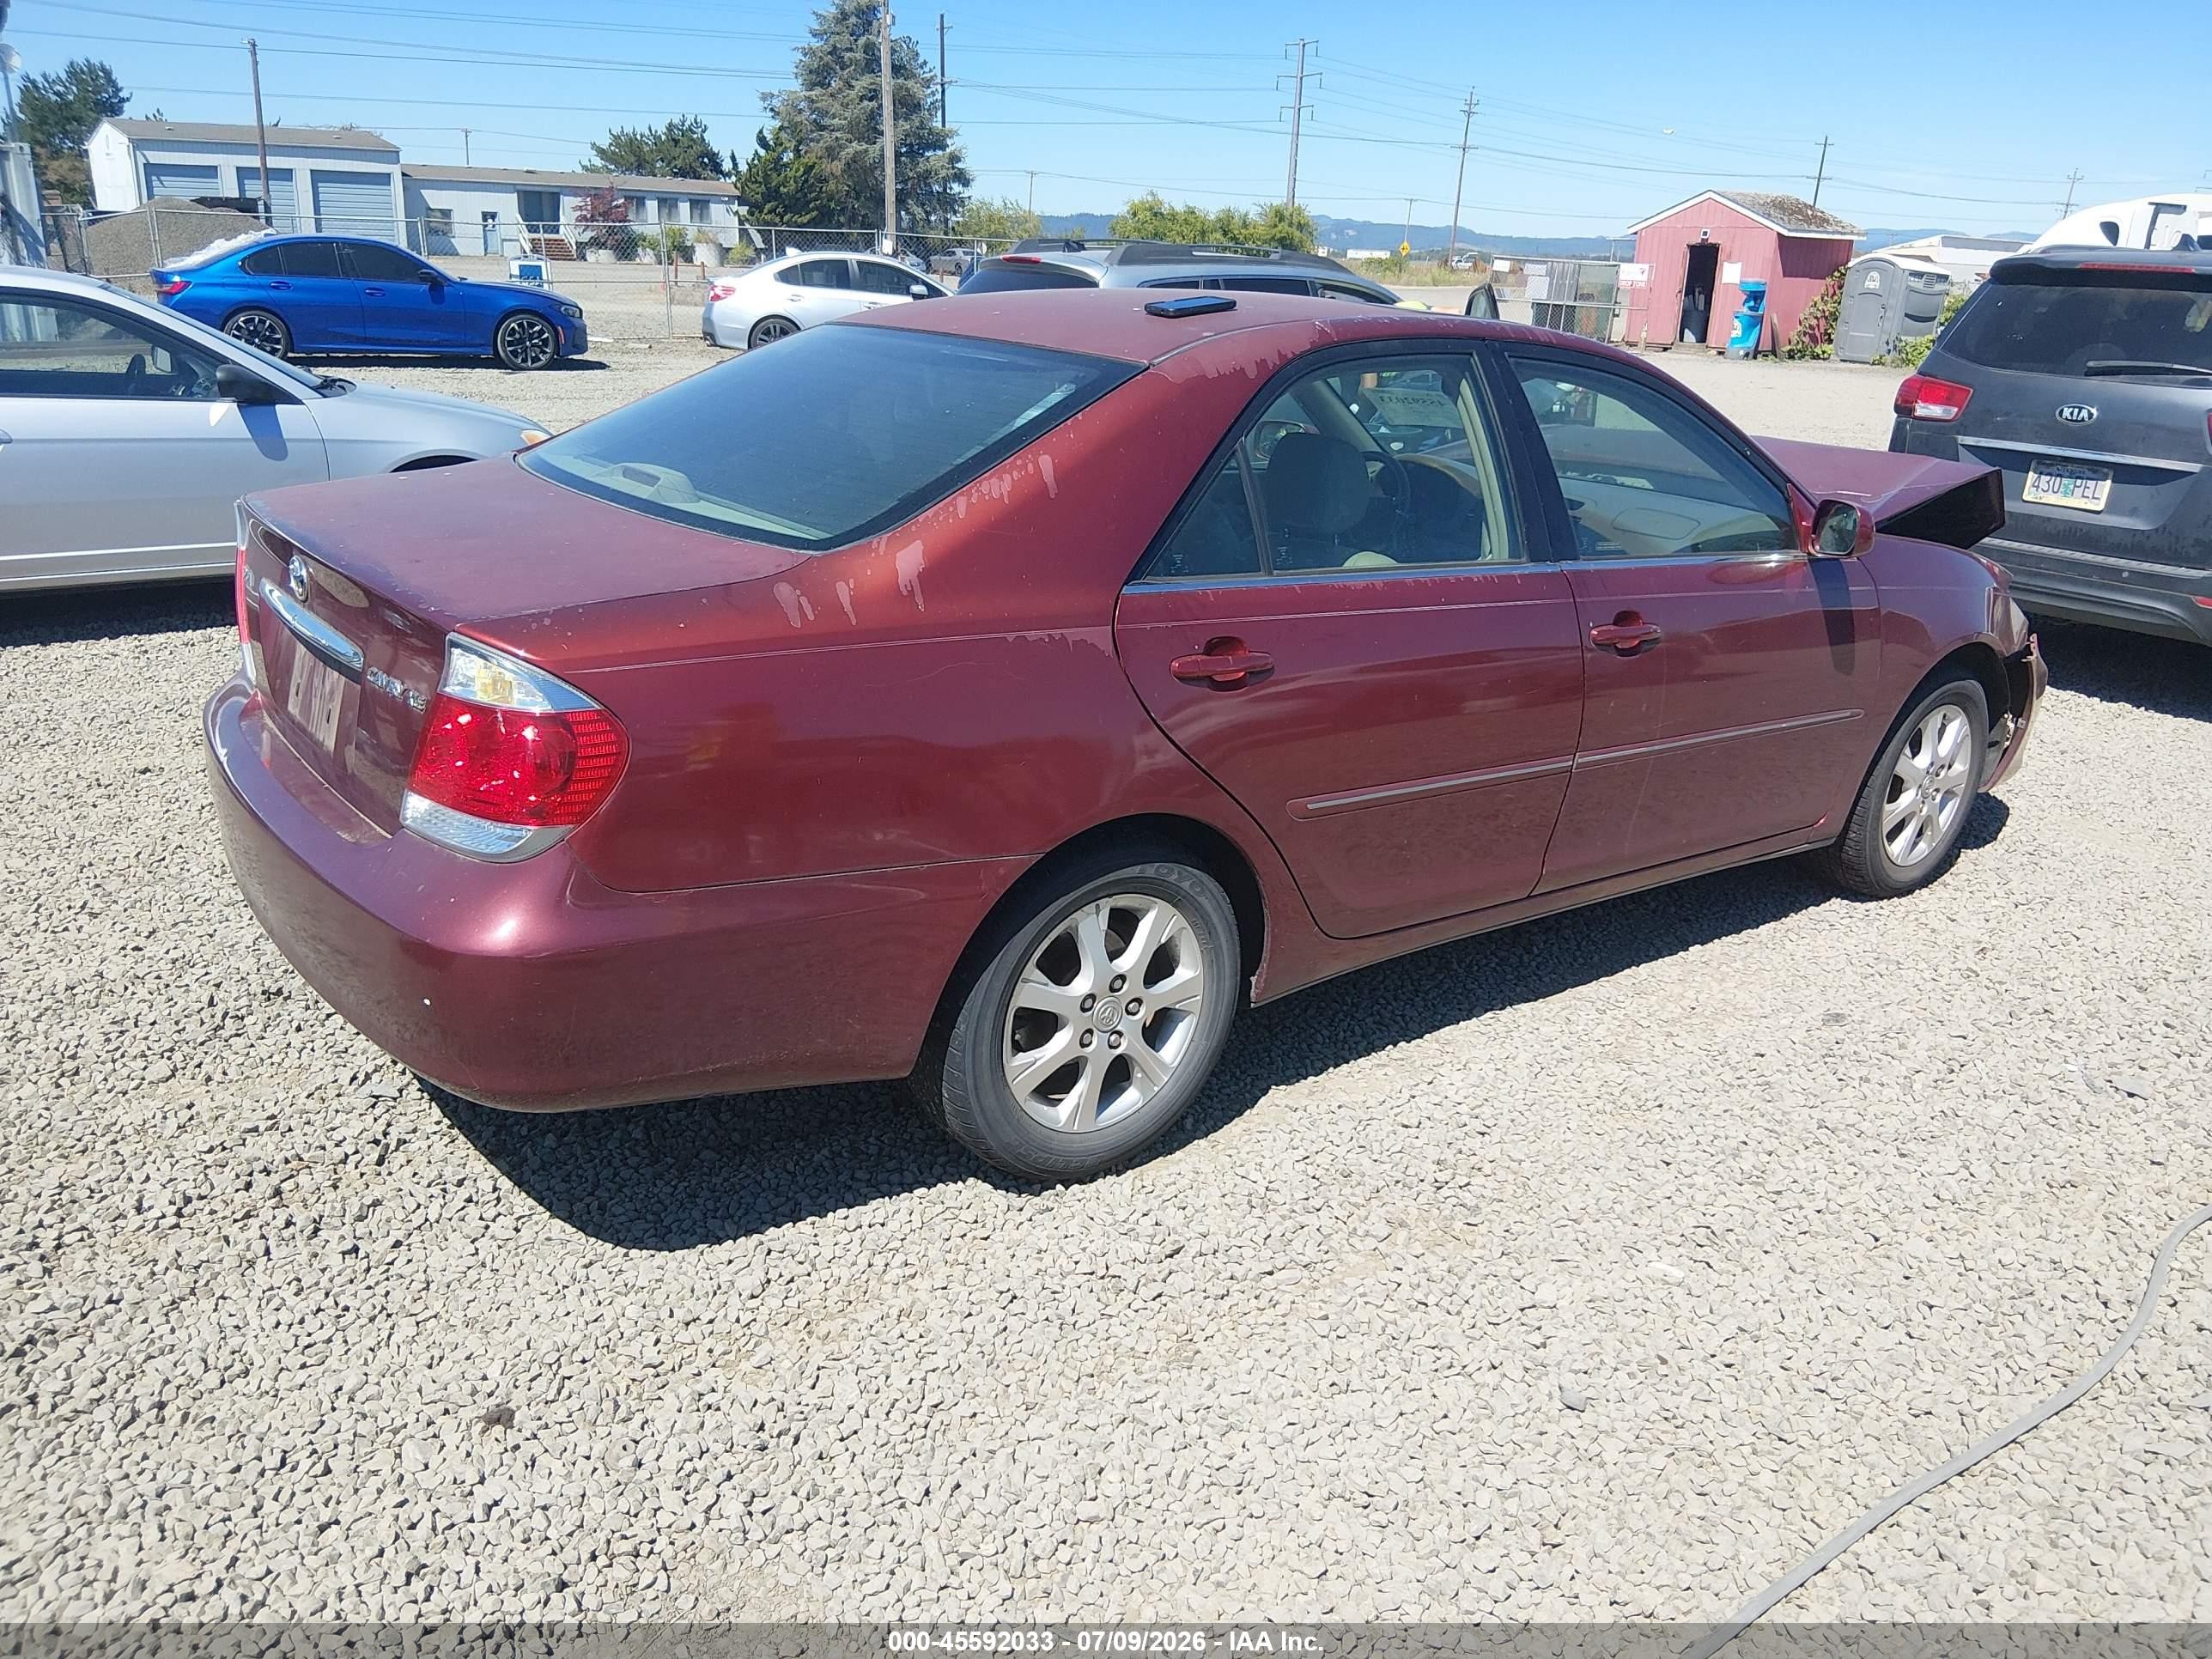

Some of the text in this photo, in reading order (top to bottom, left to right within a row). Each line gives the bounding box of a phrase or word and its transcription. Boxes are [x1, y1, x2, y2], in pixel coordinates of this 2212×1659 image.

[2062, 407, 2089, 421] KIA
[2031, 471, 2101, 501] 430 PEL
